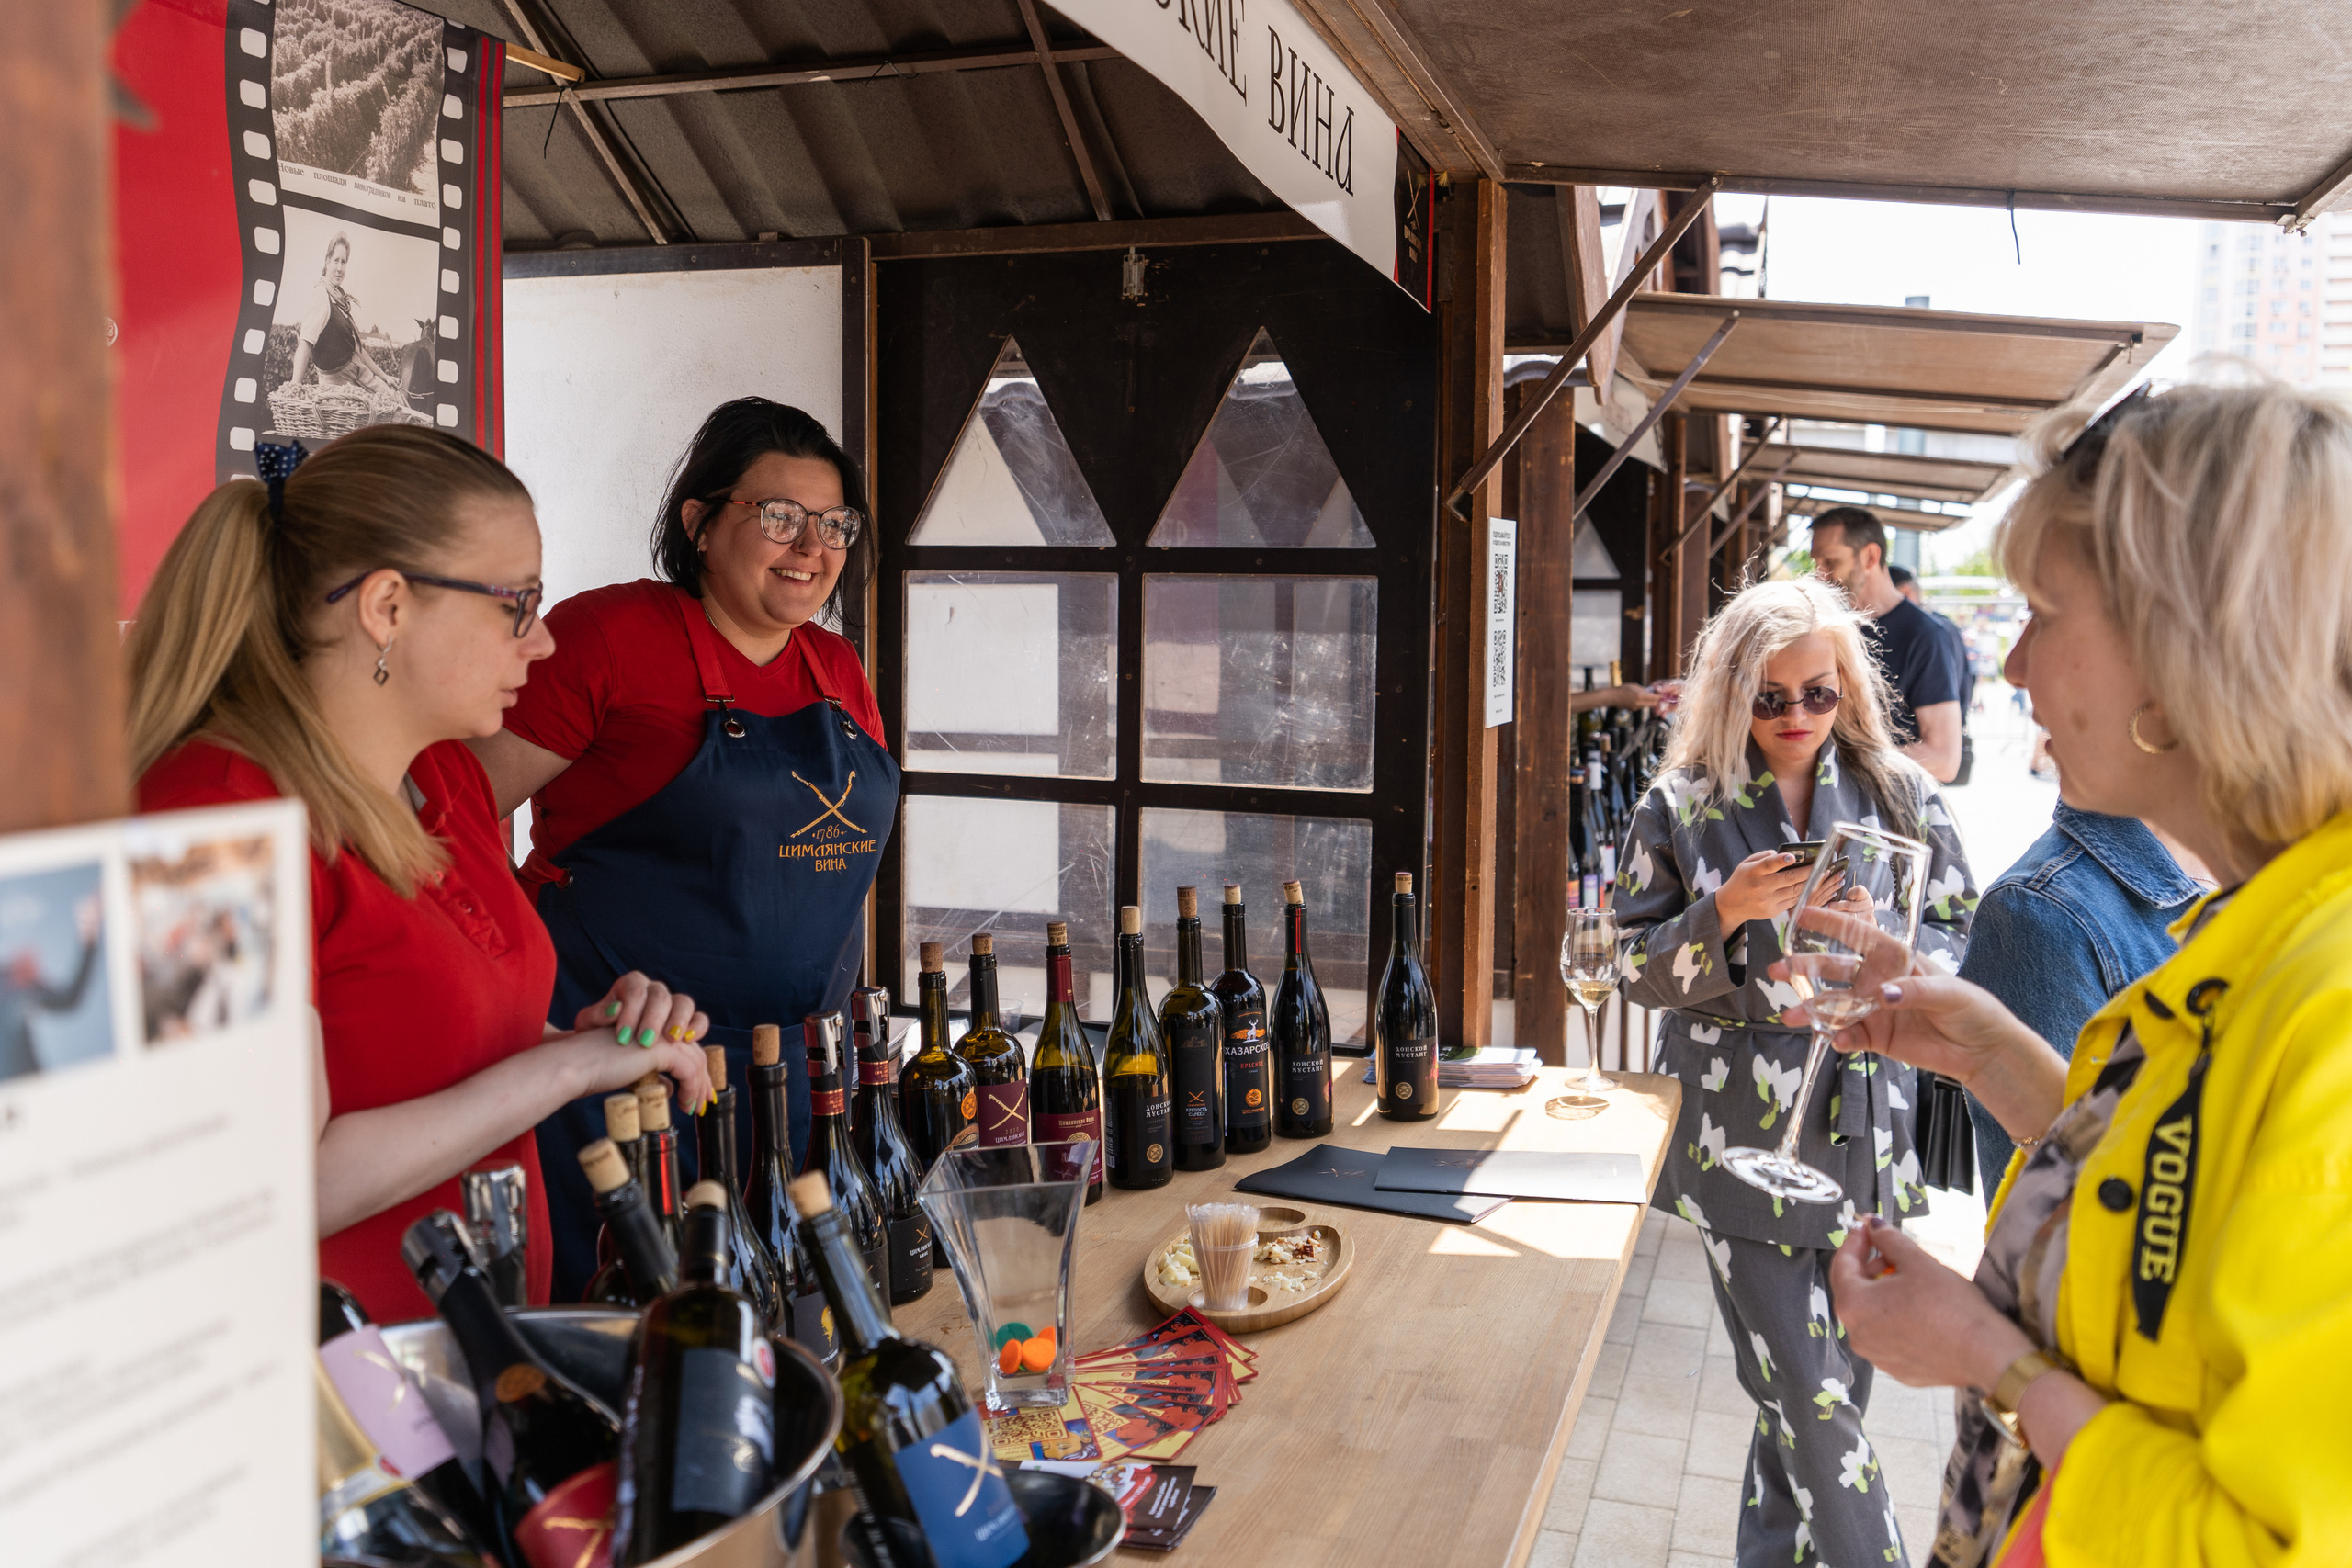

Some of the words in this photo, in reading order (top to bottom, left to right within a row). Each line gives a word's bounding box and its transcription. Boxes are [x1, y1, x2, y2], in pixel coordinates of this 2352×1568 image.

[1267, 25, 1354, 197] ВИНА
[277, 162, 305, 176] Новые
[313, 171, 347, 186] площади
[354, 181, 391, 199] виноградников
[397, 194, 406, 203] на
[414, 197, 436, 209] плато
[778, 840, 877, 858] ЦИМЛЯНСКИЕ
[815, 857, 847, 872] ВИНА
[1396, 1044, 1428, 1053] ДОНСКОЙ
[1292, 1058, 1323, 1067] ДОНСКОЙ
[2139, 1114, 2194, 1285] VOGUE
